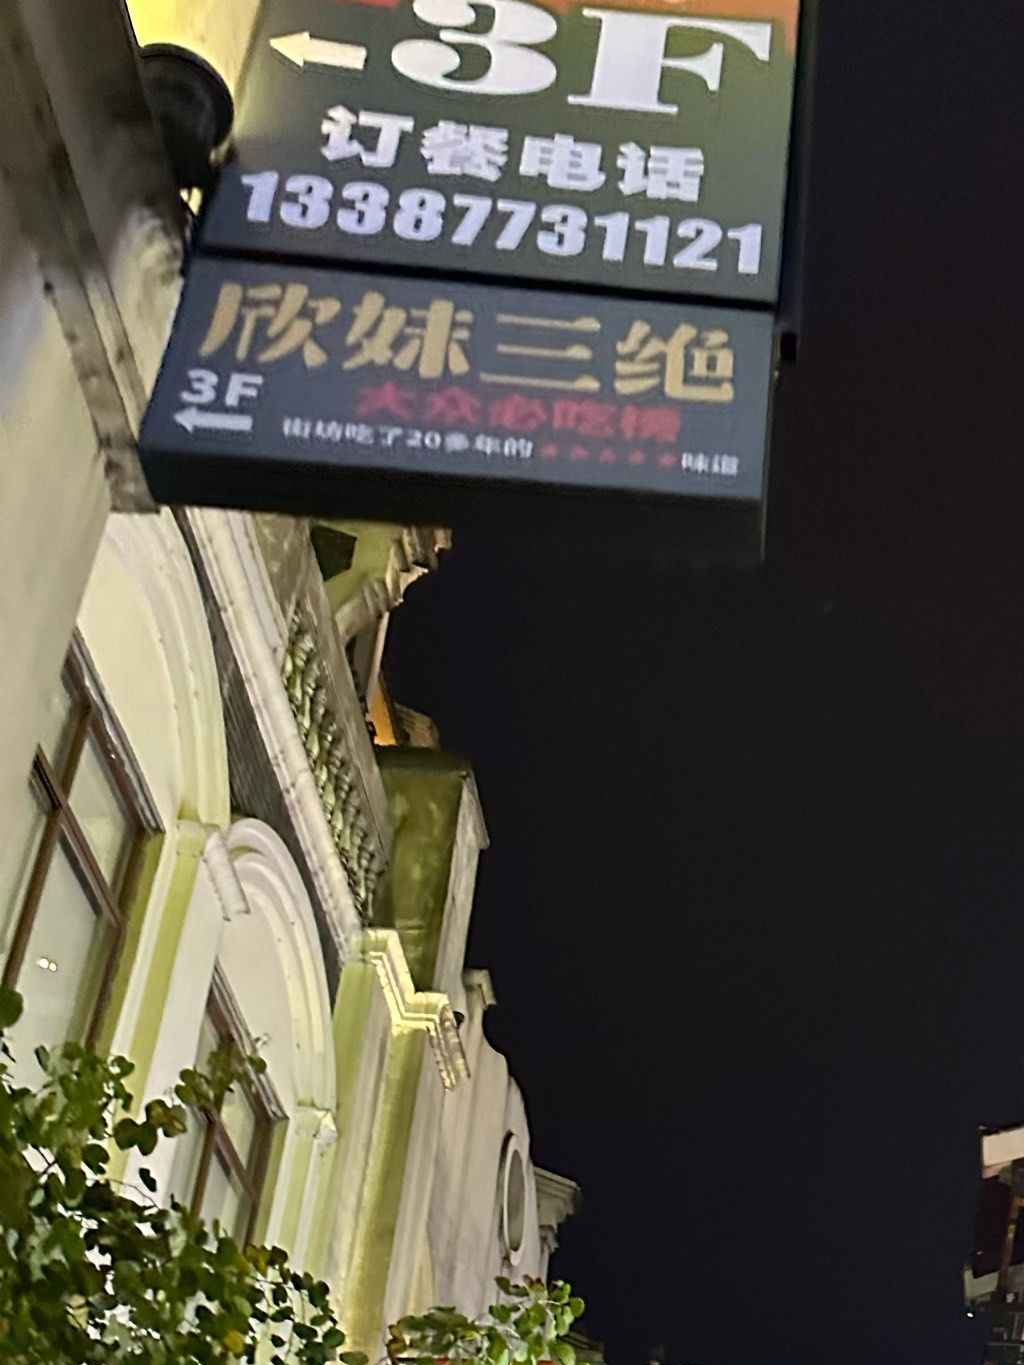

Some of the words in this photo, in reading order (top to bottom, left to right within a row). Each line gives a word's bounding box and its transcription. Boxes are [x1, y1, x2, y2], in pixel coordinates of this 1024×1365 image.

[391, 0, 771, 115] 3F
[321, 105, 704, 202] 订餐电话
[241, 170, 763, 274] 13387731121
[180, 367, 264, 407] 3F
[200, 280, 735, 404] 欣妹三绝
